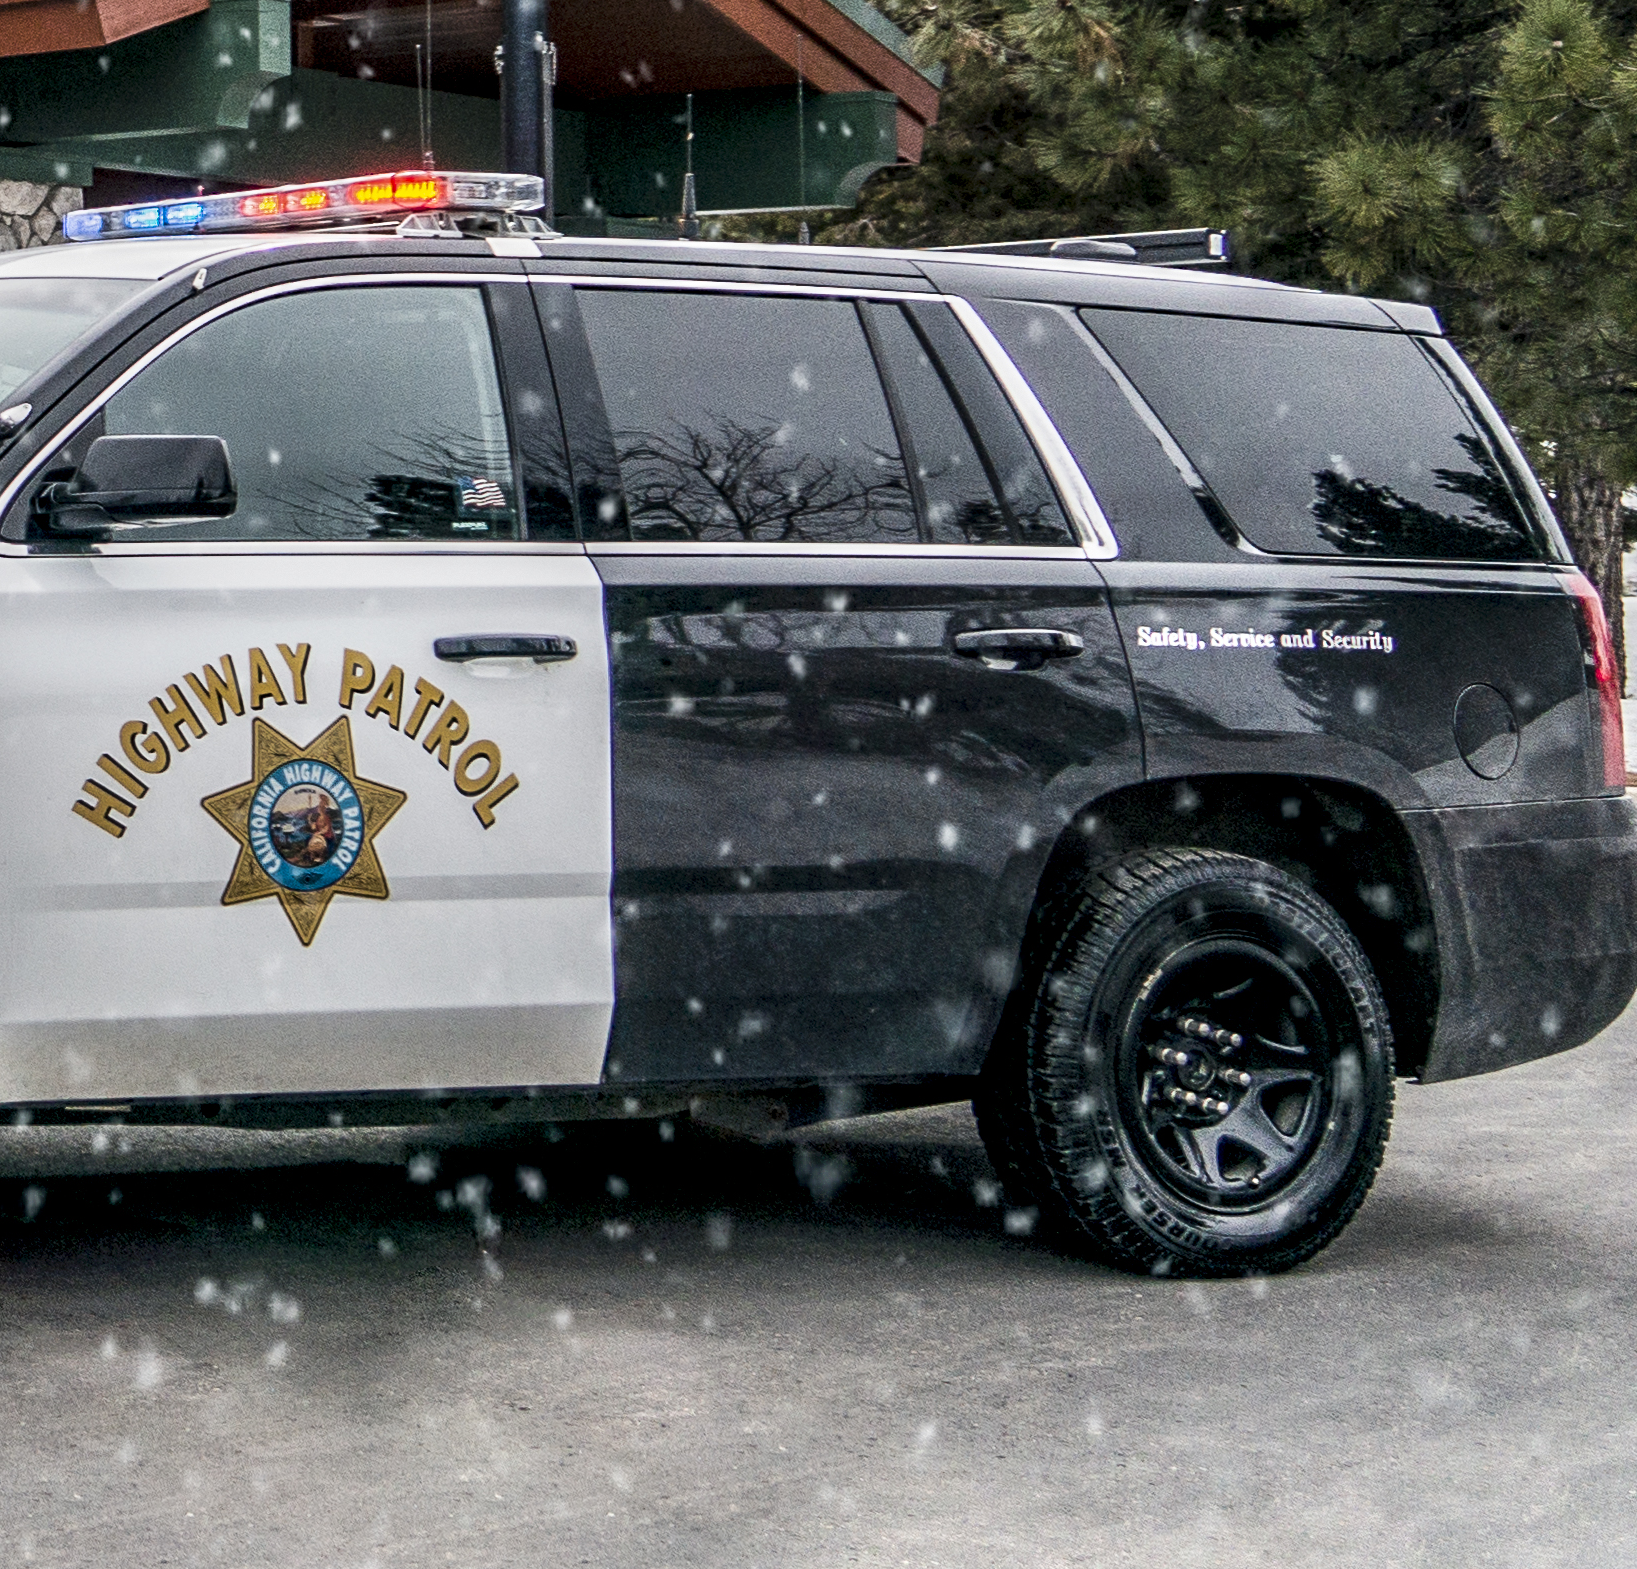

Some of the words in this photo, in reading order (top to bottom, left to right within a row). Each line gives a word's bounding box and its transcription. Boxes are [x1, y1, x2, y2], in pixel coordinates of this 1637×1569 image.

[1137, 626, 1206, 650] Safety,
[1210, 627, 1275, 648] Service
[1281, 629, 1315, 649] and
[1322, 629, 1394, 653] Security
[71, 642, 311, 839] HIGHWAY
[338, 647, 520, 830] PATROL
[251, 776, 284, 874] CALIFORNIA
[283, 763, 355, 802] HIGHWAY
[331, 806, 362, 872] PATROL
